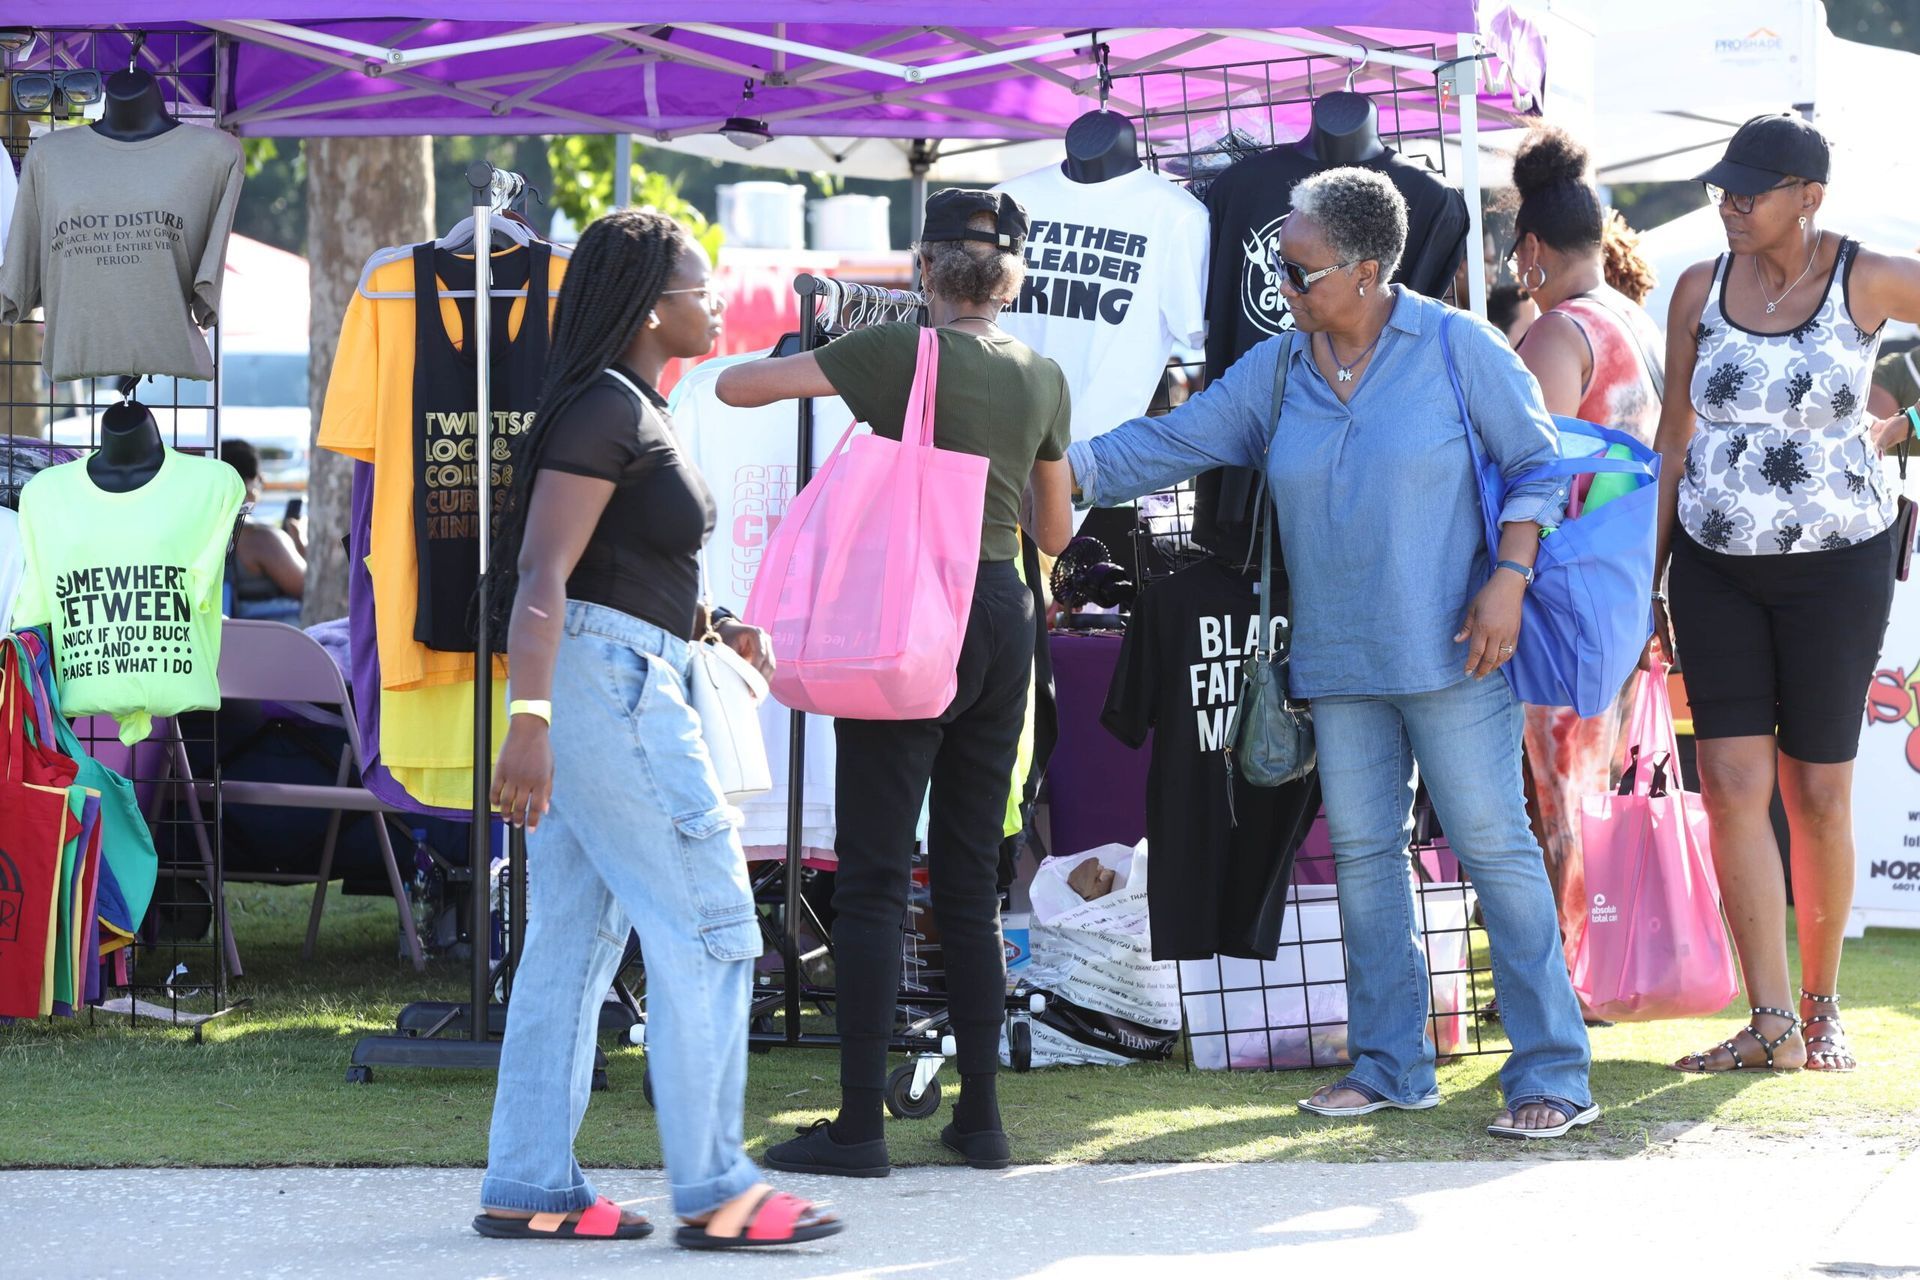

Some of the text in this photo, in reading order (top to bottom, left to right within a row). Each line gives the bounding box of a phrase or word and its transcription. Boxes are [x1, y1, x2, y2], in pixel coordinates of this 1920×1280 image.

[70, 214, 109, 230] NOT
[115, 210, 184, 230] DISTURB
[66, 233, 91, 245] EACE.
[93, 231, 110, 241] MY
[136, 228, 152, 239] MY
[75, 244, 113, 256] WHOLE
[116, 241, 153, 253] ENTIRE
[155, 240, 171, 250] VIB
[1027, 221, 1148, 258] FATHER
[1024, 247, 1142, 284] LEADER
[425, 411, 537, 435] TWITS&
[60, 591, 192, 629] ETWEEN
[62, 625, 191, 650] NUCK IF YOU BUCK
[1199, 614, 1289, 659] BLAC
[102, 641, 131, 658] AND
[63, 658, 192, 682] PAISE IS WHAT I DO
[1189, 659, 1241, 706] FAT
[1130, 891, 1148, 902] THAN
